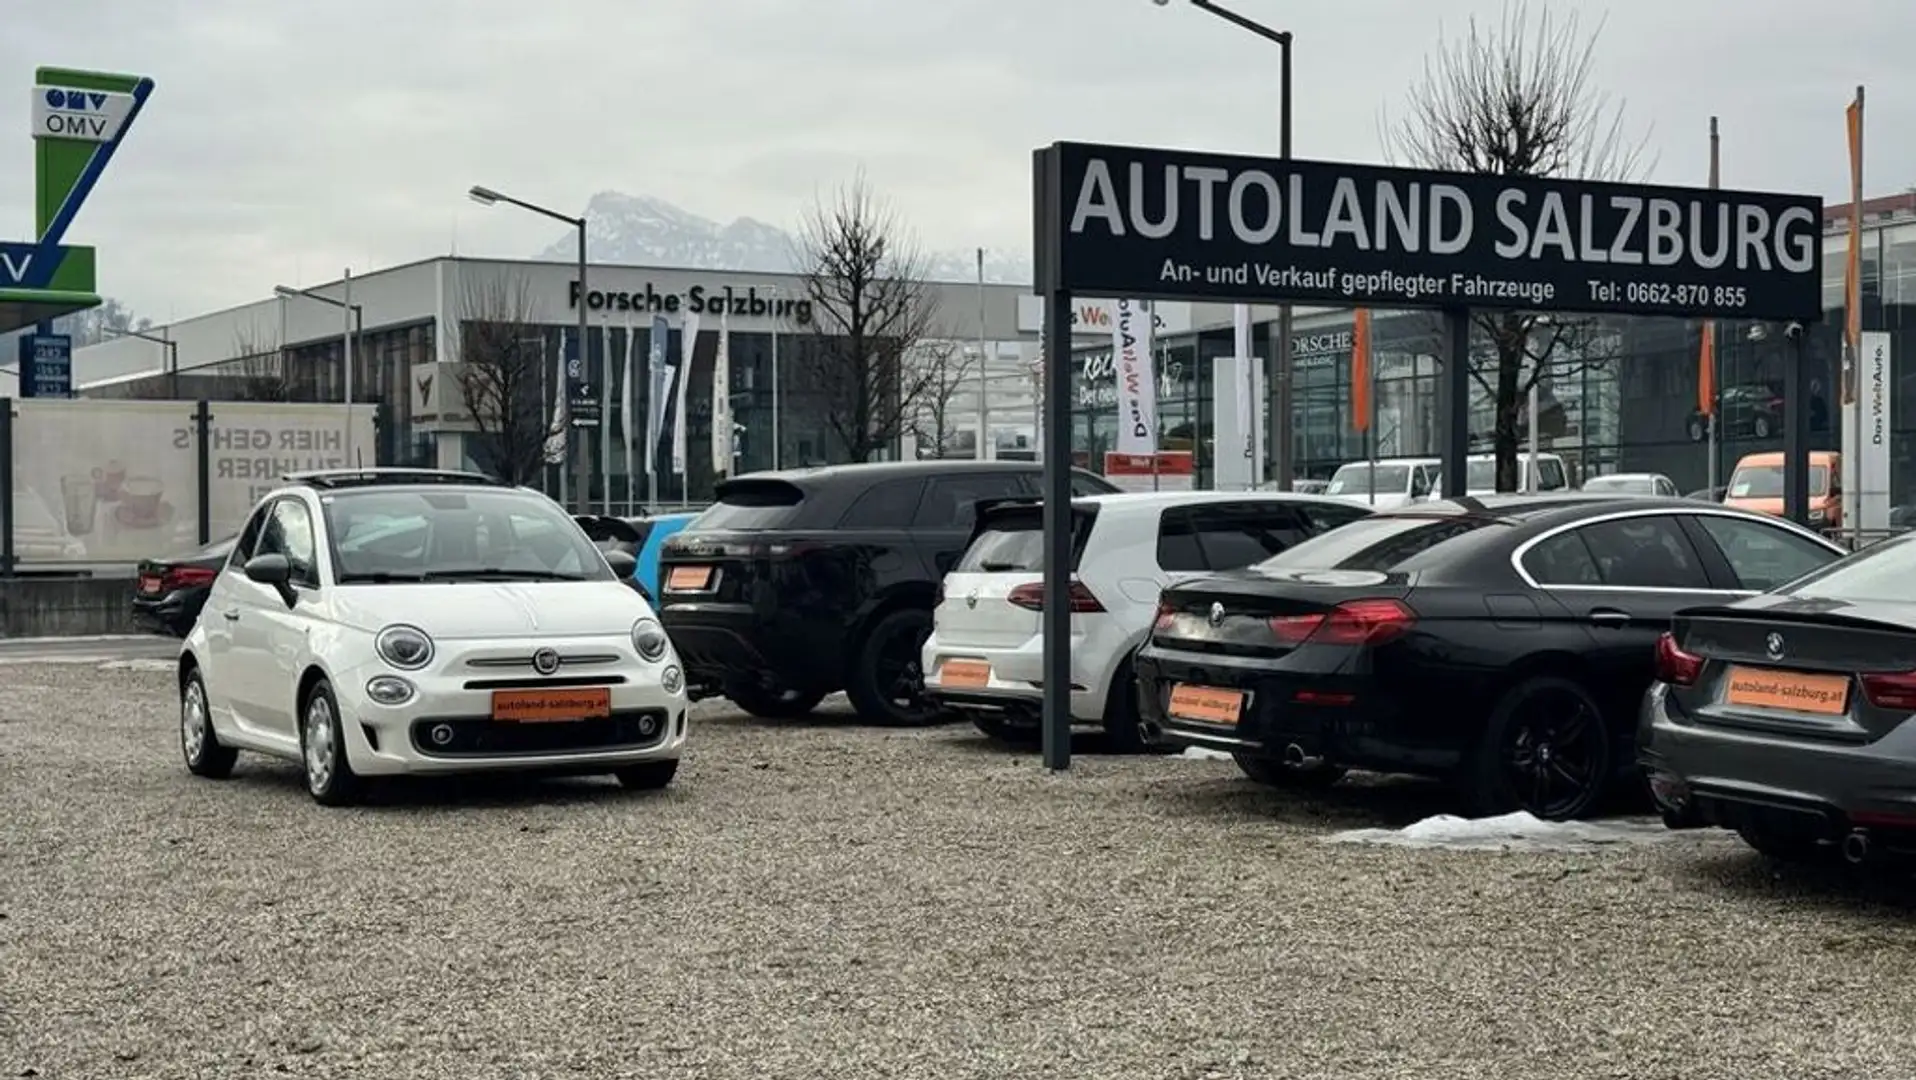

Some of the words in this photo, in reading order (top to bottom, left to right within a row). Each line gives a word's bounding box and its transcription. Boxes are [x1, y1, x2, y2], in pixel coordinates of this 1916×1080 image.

[46, 114, 107, 136] OMV
[1069, 157, 1474, 256] AUTOLAND
[1494, 187, 1815, 274] SALZBURG
[1160, 258, 1200, 283] An-
[1207, 262, 1248, 285] und
[1254, 263, 1337, 290] Verkauf
[1342, 268, 1447, 299] gepflegter
[1451, 273, 1555, 304] Fahrzeuge
[1587, 279, 1622, 302] Tel:
[1627, 282, 1708, 306] 0662-870
[1714, 286, 1747, 307] 855
[569, 281, 682, 313] Porsche
[689, 285, 813, 326] Salzburg
[1731, 681, 1843, 703] autoland-salzburg.at
